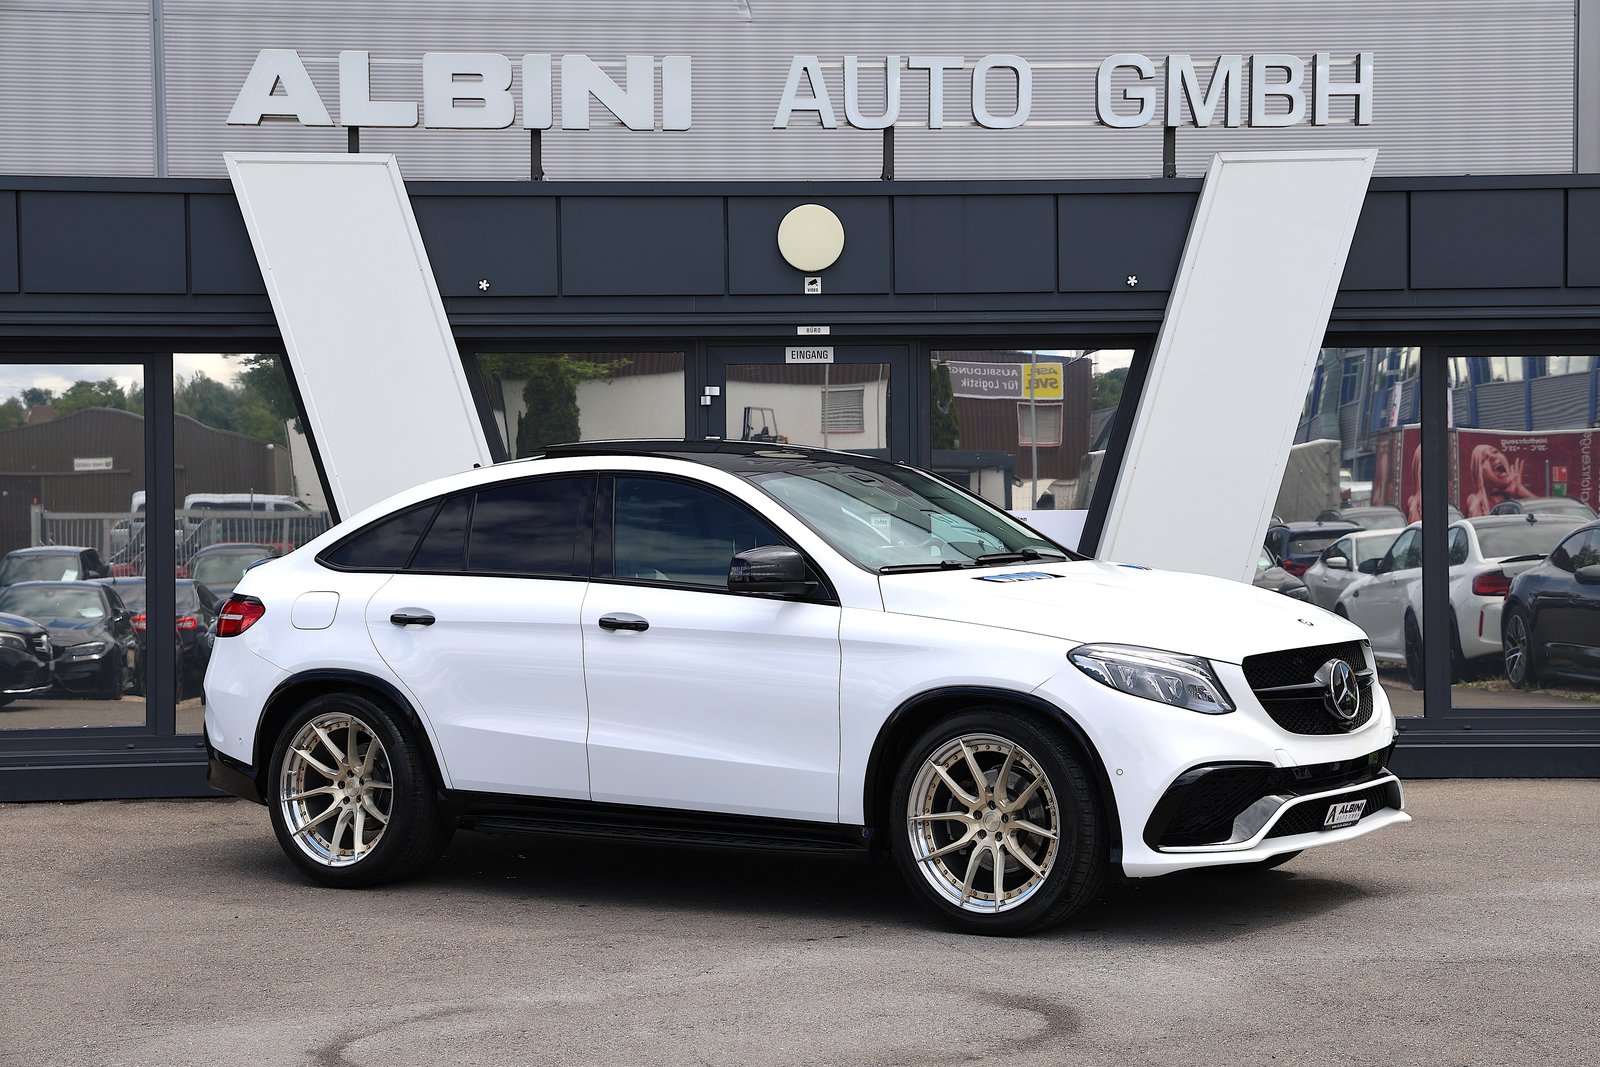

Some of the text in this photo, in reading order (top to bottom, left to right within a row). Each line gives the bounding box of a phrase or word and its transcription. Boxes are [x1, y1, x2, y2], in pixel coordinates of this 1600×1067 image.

[226, 49, 1374, 131] ALBINI AUTO GMBH
[791, 350, 829, 360] EINGANG
[1338, 803, 1364, 814] ALBINI
